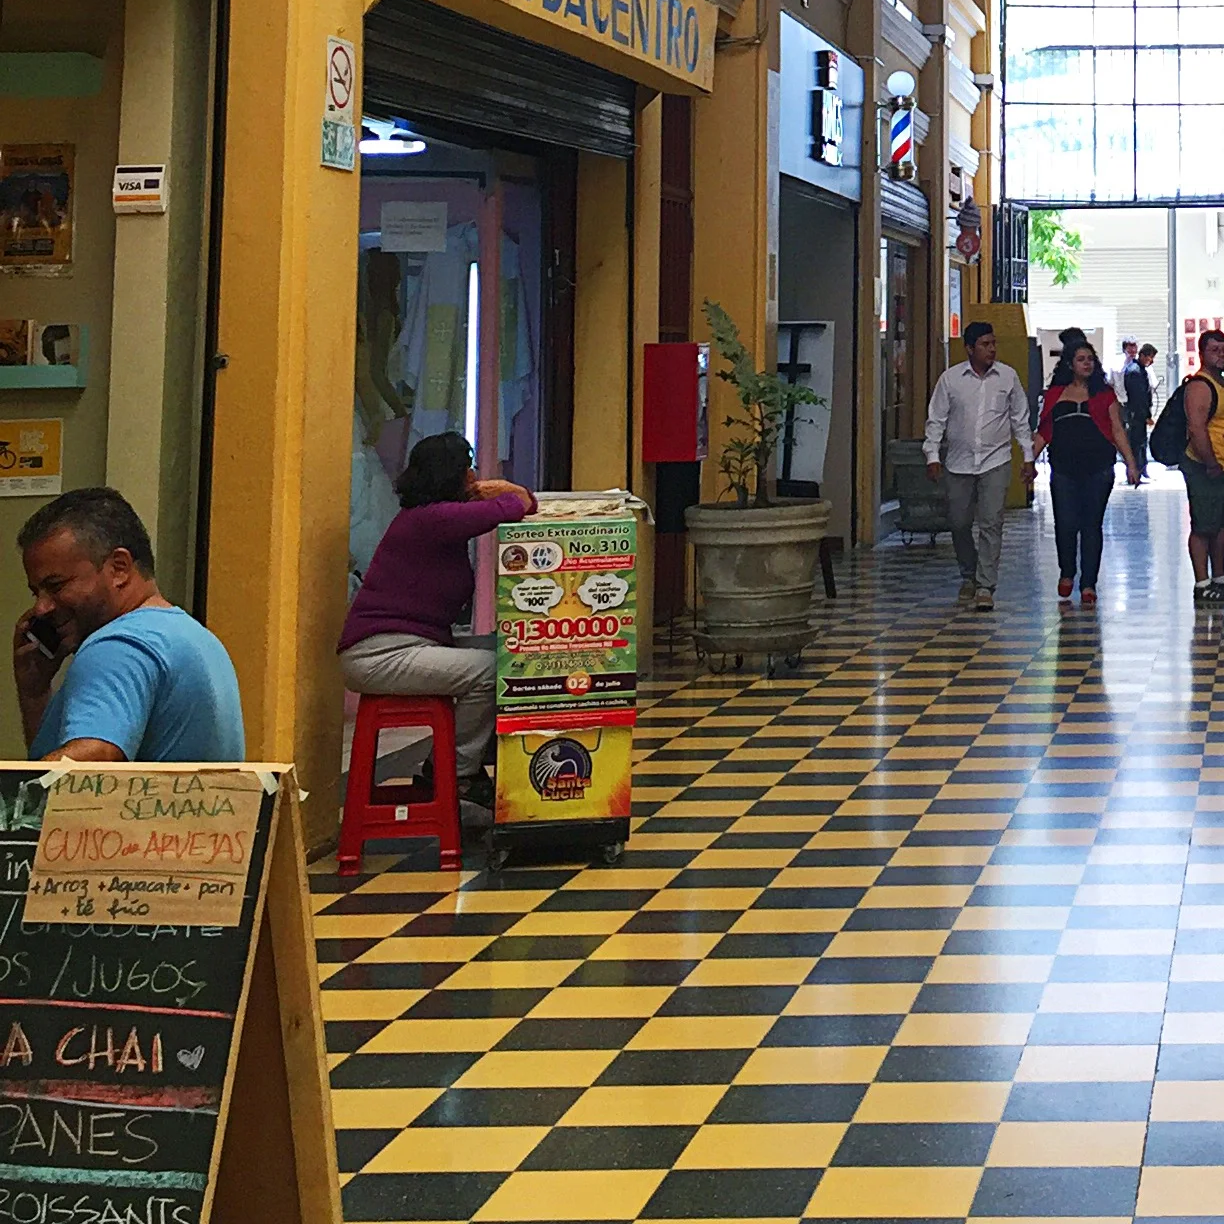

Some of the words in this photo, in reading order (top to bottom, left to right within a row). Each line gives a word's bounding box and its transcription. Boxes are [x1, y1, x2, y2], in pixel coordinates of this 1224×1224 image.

[119, 182, 141, 191] VISA
[507, 528, 545, 539] Sorteo
[548, 526, 630, 537] Extraordinario
[569, 541, 595, 553] No.
[600, 539, 630, 552] 310
[568, 677, 588, 689] 02
[52, 774, 119, 798] PLATO
[128, 776, 159, 797] DE
[173, 774, 205, 795] LA
[547, 776, 591, 788] Santa
[120, 796, 236, 820] SEMANA
[43, 827, 122, 862] GUISO
[143, 830, 248, 865] ARVEJAS
[199, 882, 236, 900] pan
[56, 1025, 163, 1073] CHAI
[0, 1103, 159, 1163] PANES
